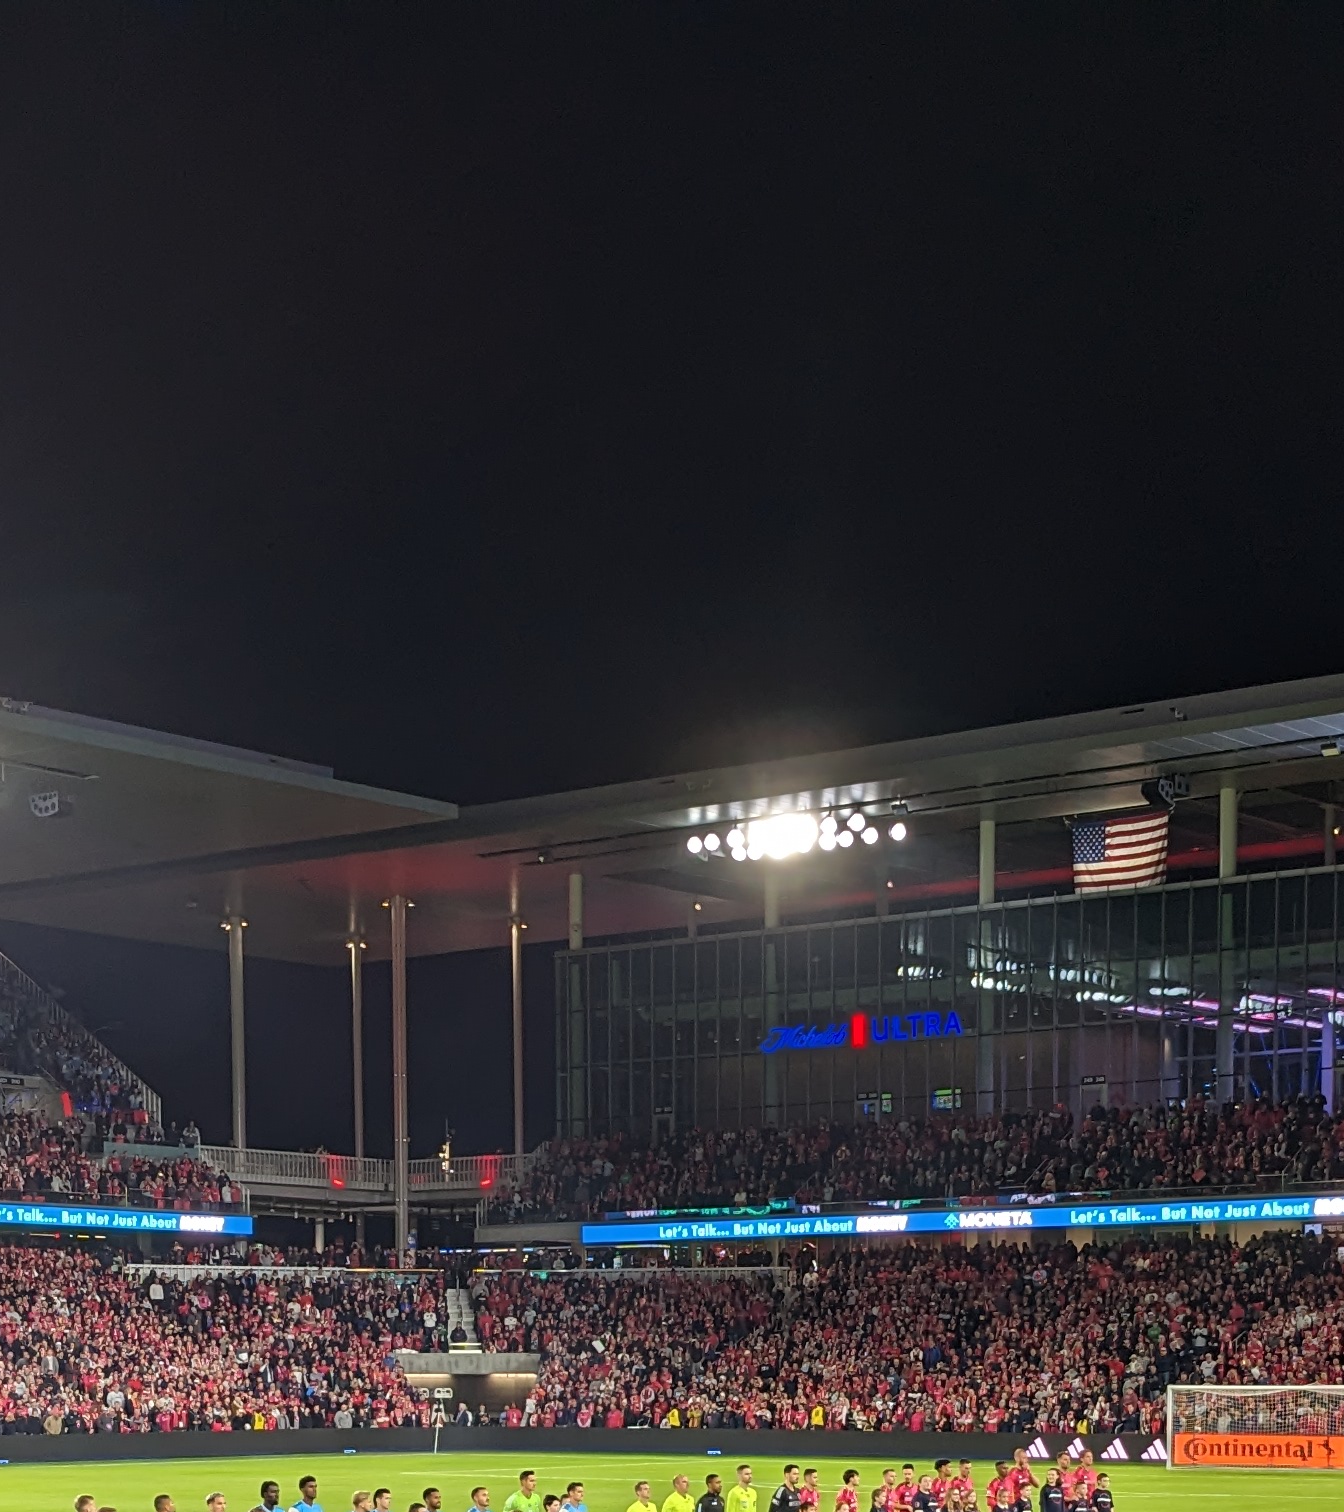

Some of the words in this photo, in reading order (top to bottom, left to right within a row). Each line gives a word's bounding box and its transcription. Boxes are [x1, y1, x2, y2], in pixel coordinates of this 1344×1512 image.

[871, 1011, 962, 1041] ULTRA
[61, 1210, 83, 1225] But
[86, 1212, 109, 1226] Not
[112, 1213, 137, 1227] Just
[140, 1214, 177, 1229] About
[959, 1211, 1033, 1228] MONETA
[1070, 1210, 1105, 1224] Let's
[1161, 1206, 1187, 1220] But
[1191, 1204, 1220, 1219] Not
[1224, 1203, 1256, 1218] Just
[1261, 1201, 1310, 1216] About
[659, 1226, 688, 1239] Let's
[733, 1223, 754, 1236] But
[757, 1222, 781, 1235] Not
[785, 1221, 811, 1233] Just
[813, 1219, 853, 1233] About
[1183, 1438, 1313, 1462] Continental
